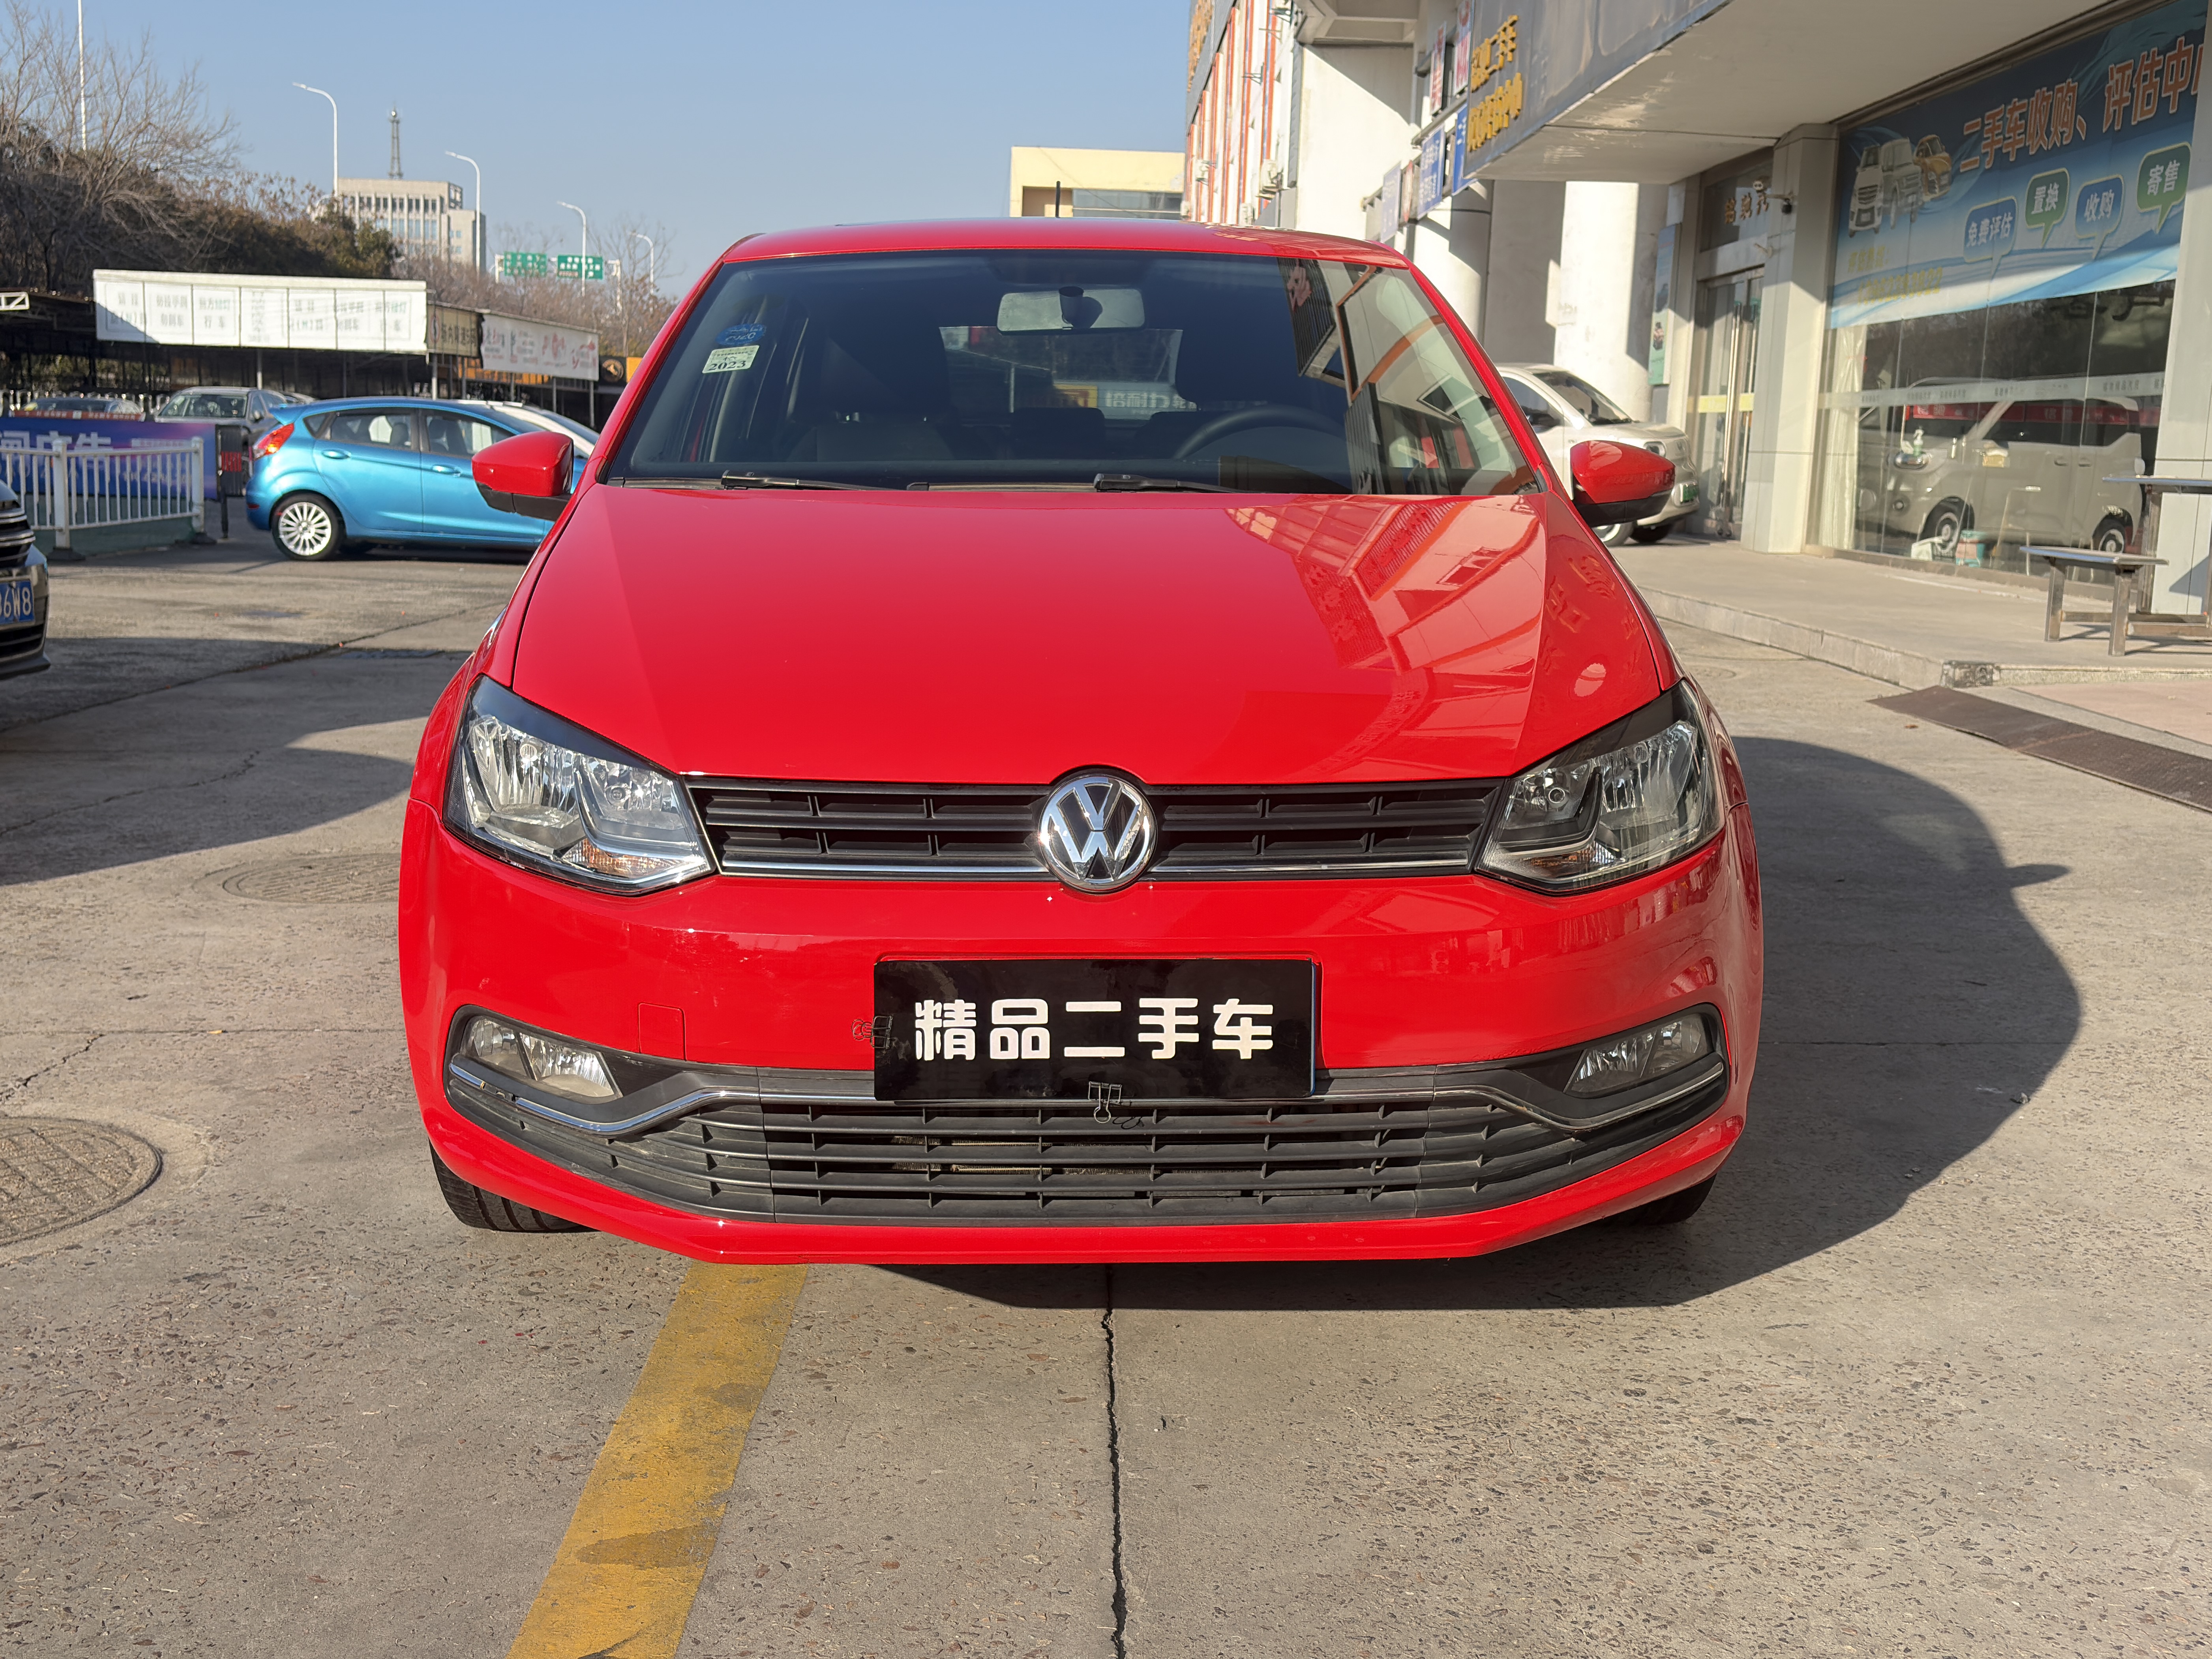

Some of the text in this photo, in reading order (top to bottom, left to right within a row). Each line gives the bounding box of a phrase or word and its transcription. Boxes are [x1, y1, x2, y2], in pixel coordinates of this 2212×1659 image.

[1959, 36, 2204, 173] 二手车收购、评估中
[2147, 160, 2180, 195] 寄售
[2032, 182, 2059, 214] 置换
[2084, 189, 2115, 222] 收购
[1966, 211, 2013, 248] 免费评估
[708, 360, 746, 371] 2023
[0, 586, 32, 618] 6W8
[915, 998, 1274, 1061] 精品二手车
